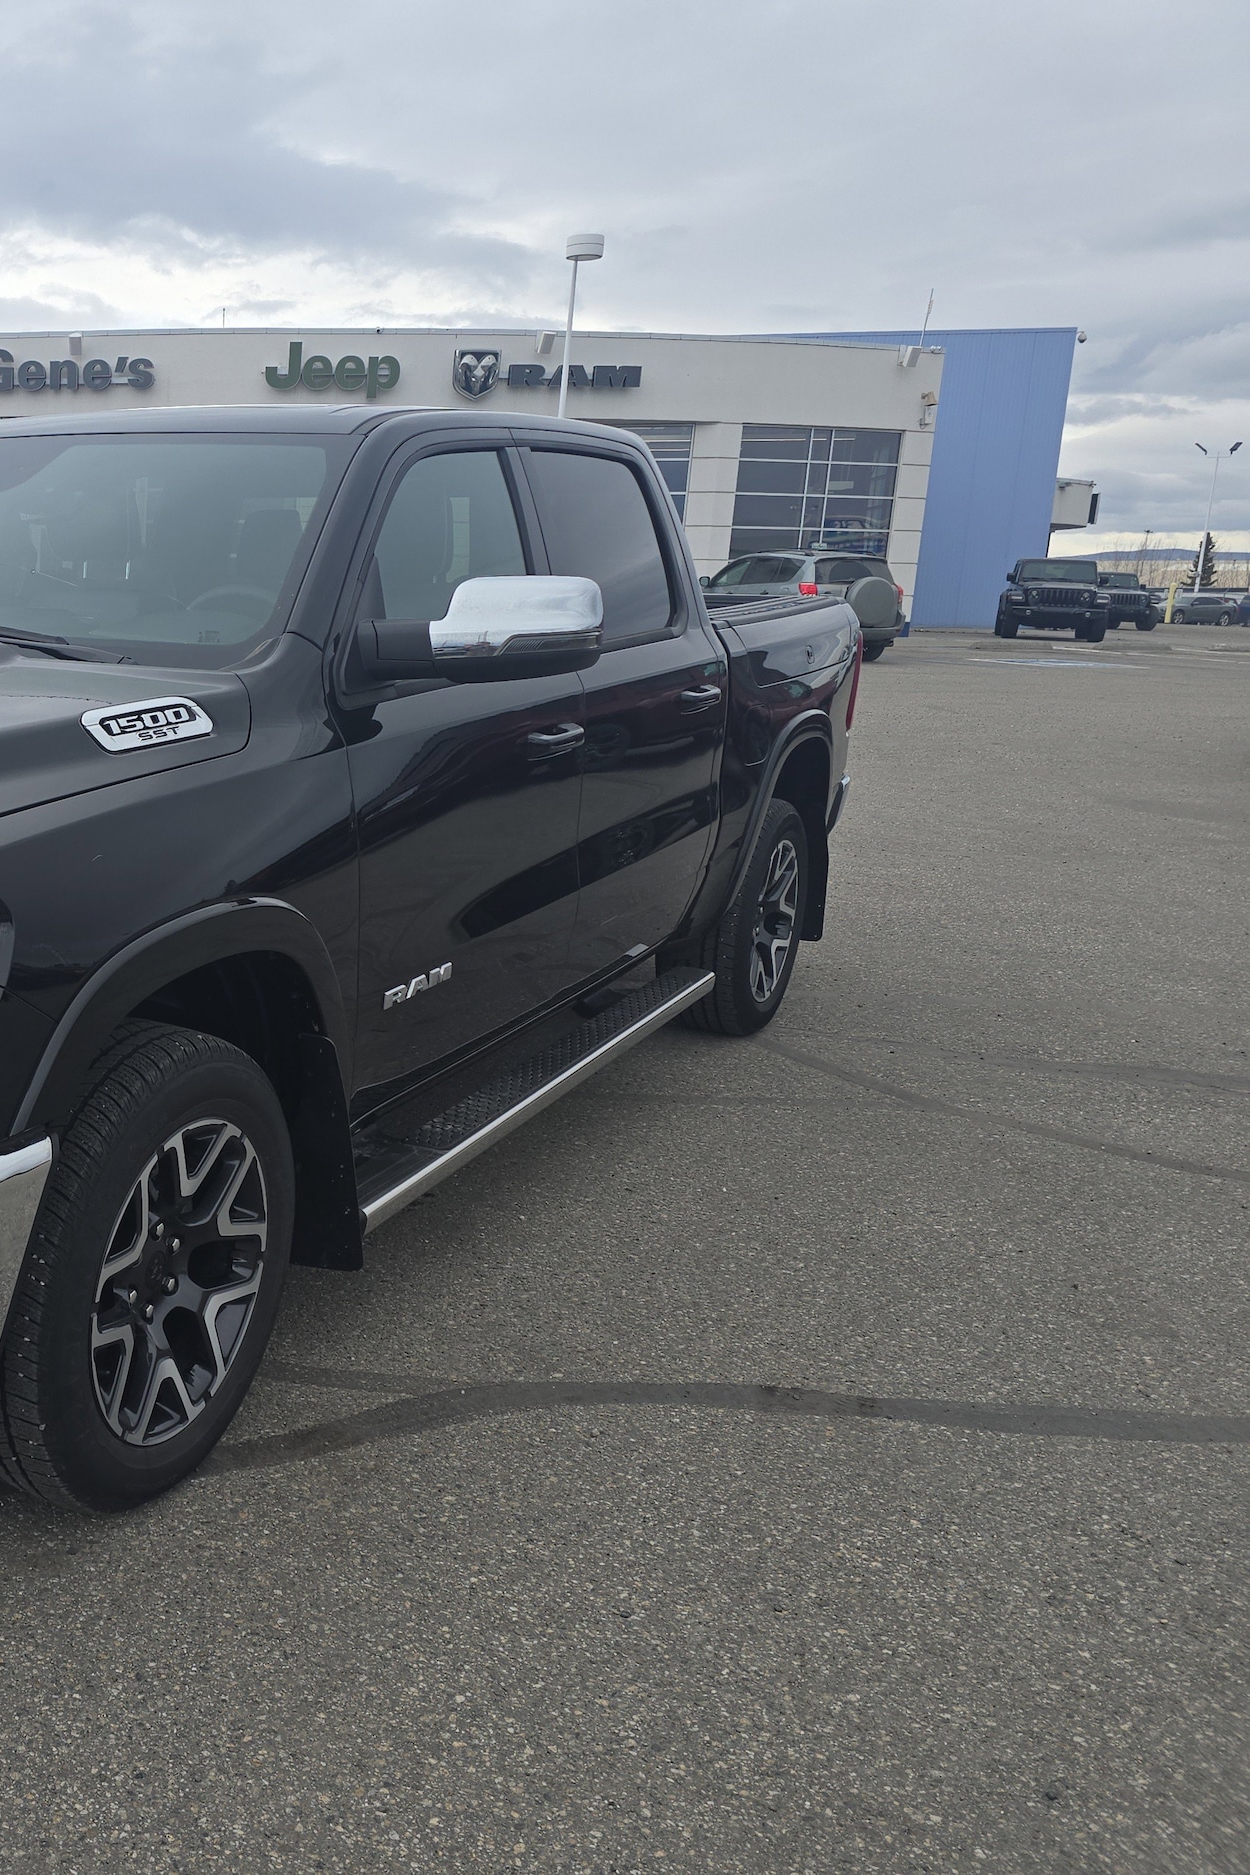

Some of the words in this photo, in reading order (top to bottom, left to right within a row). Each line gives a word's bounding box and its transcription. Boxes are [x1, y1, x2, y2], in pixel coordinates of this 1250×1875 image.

[265, 341, 401, 399] Jeep
[507, 364, 643, 388] RAM
[102, 706, 191, 736] 1500
[137, 725, 181, 741] SST
[382, 961, 453, 1011] RAM
